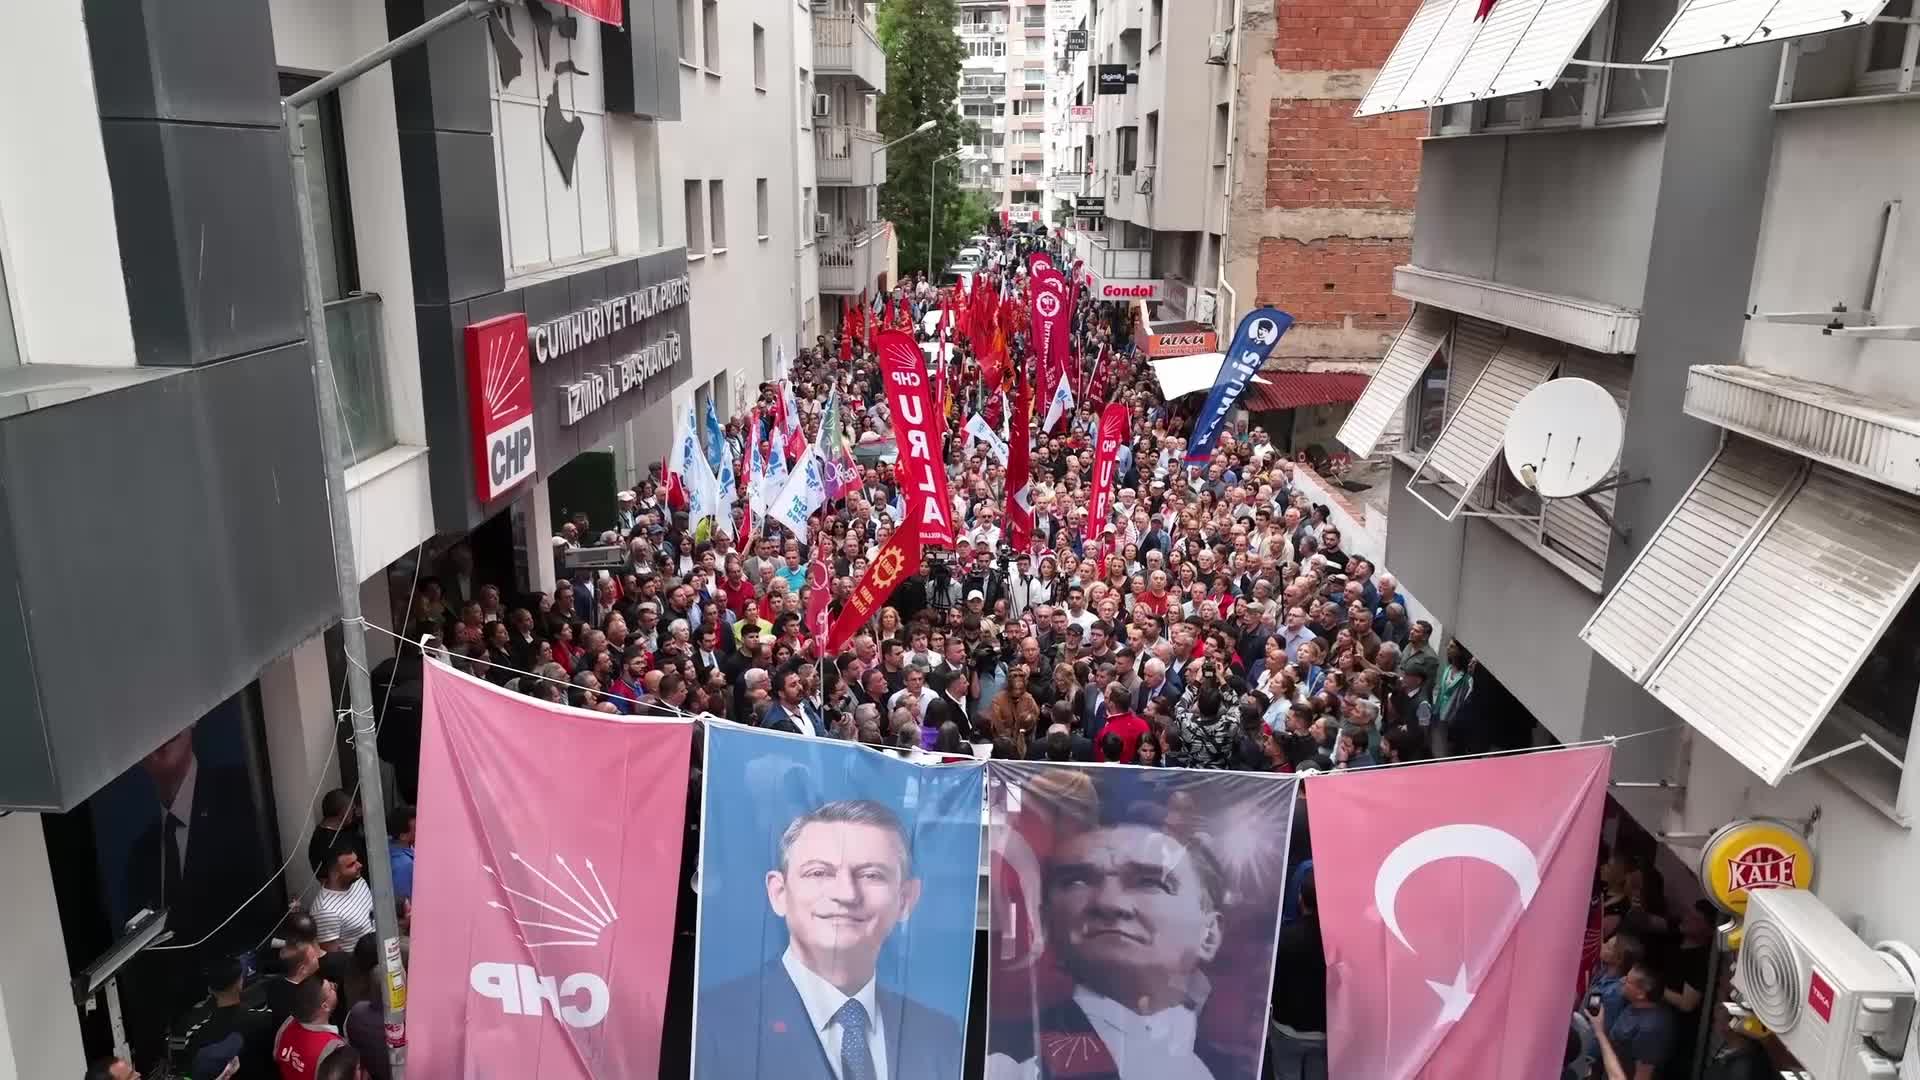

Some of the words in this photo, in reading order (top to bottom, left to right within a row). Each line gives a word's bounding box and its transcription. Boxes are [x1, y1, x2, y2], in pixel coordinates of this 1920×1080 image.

[1103, 285, 1153, 297] Gondol
[536, 298, 627, 364] CUMHURİYET
[630, 286, 659, 325] HALK
[661, 275, 690, 311] PARTİS
[568, 373, 605, 425] İZMİR
[608, 365, 619, 400] İL
[621, 332, 680, 393] BAŞKANLIĞI
[491, 426, 531, 485] CHP
[1102, 440, 1116, 452] CHP
[1731, 857, 1794, 892] KALE
